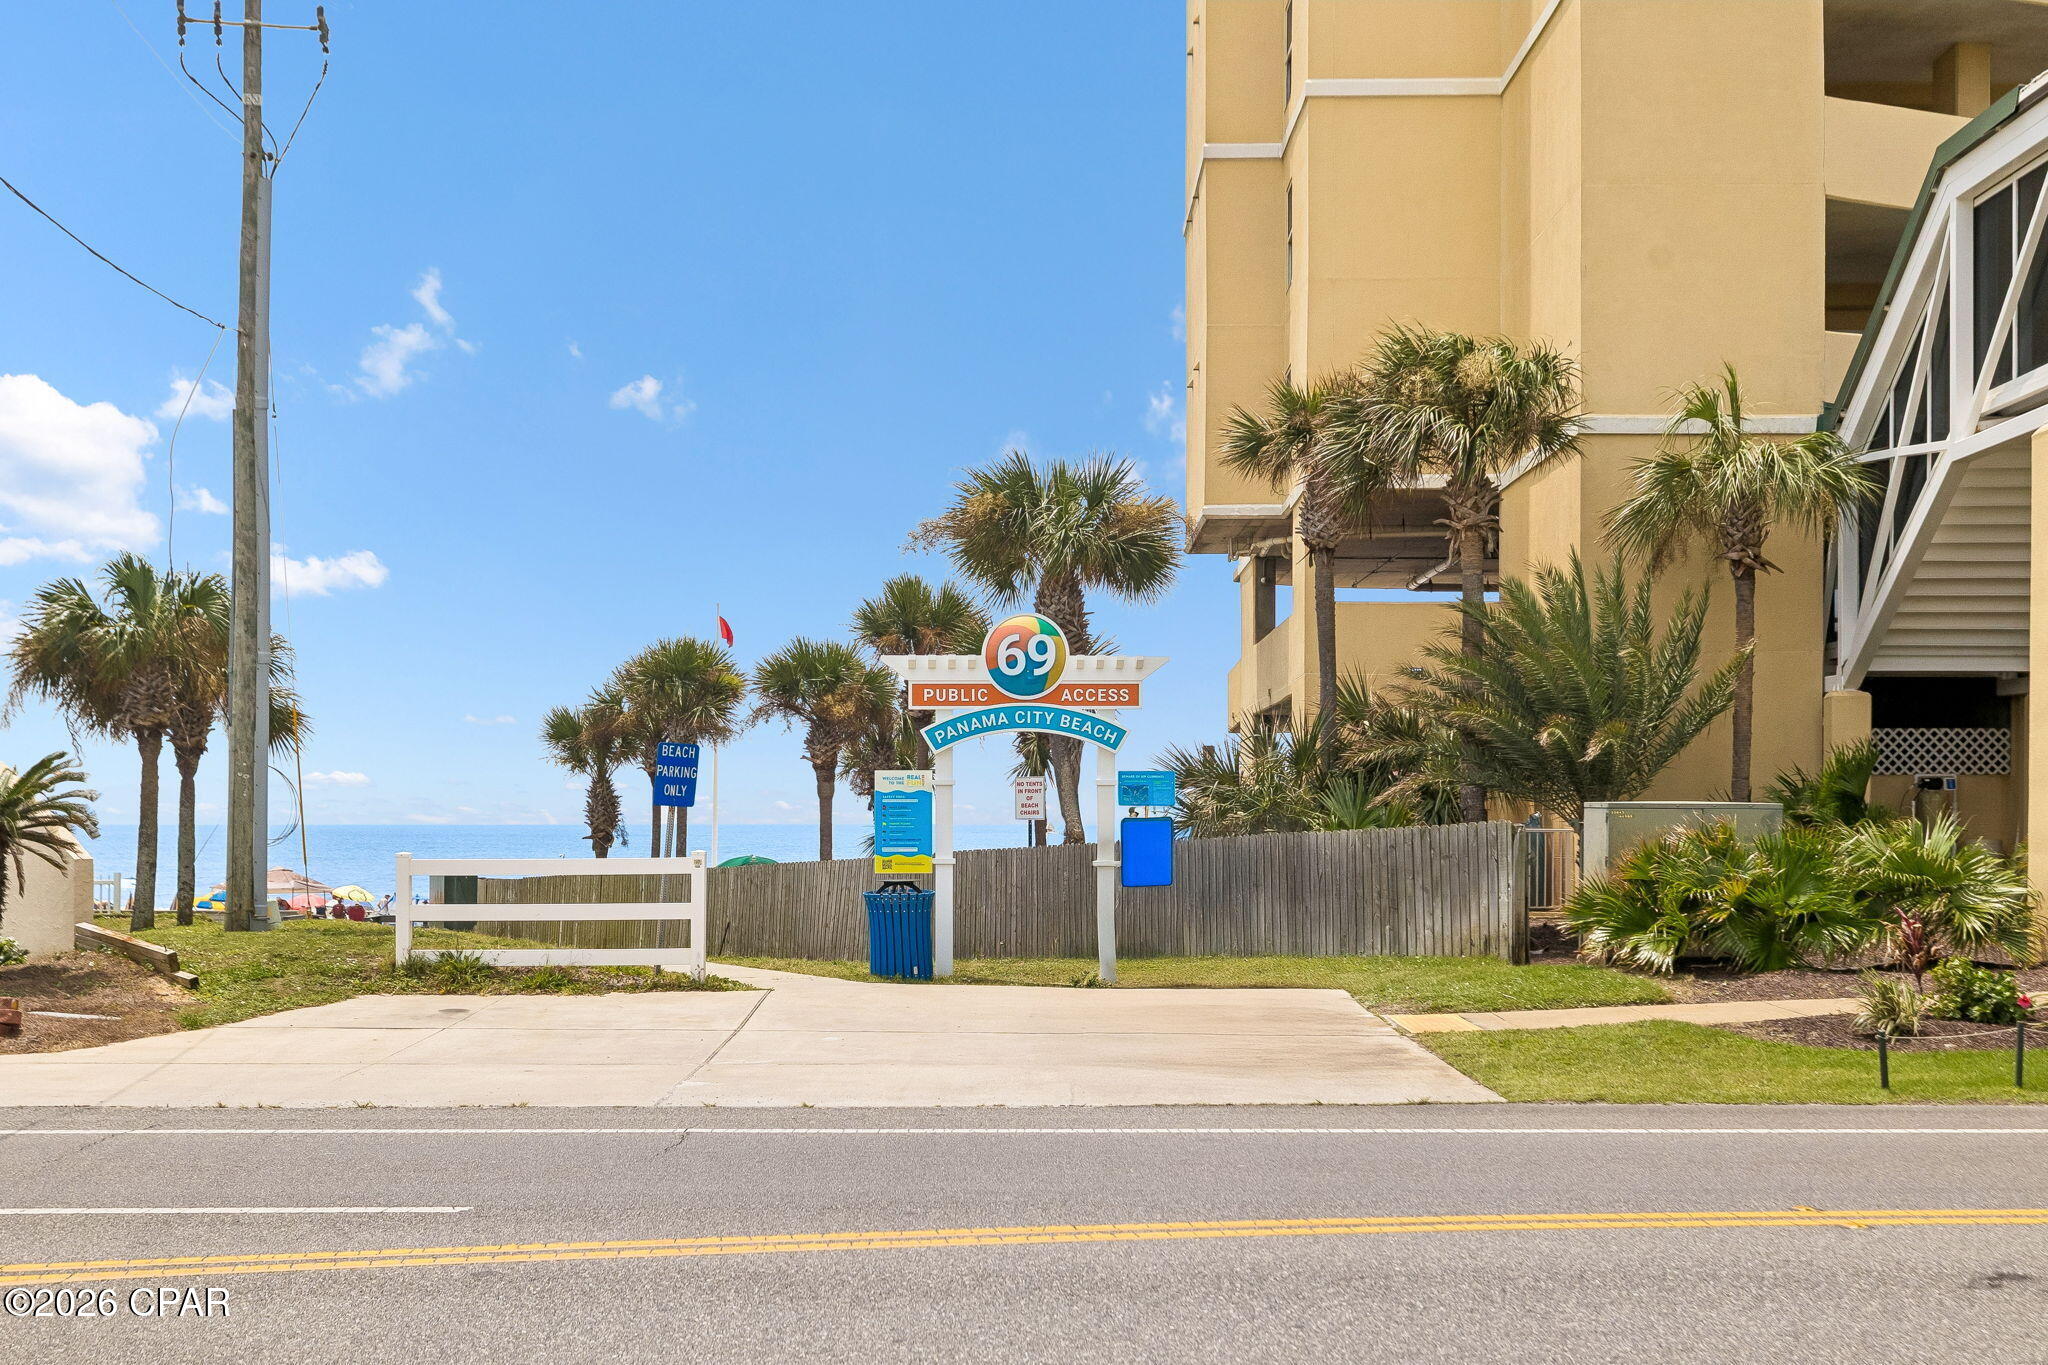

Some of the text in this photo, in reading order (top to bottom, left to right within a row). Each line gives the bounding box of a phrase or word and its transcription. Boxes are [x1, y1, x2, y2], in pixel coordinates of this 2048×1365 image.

[997, 633, 1056, 677] 69
[923, 688, 1130, 702] PUBLIC ACCESS
[934, 710, 1118, 744] PANAMA CITY BEACH
[661, 744, 696, 759] BEACH
[656, 764, 698, 779] PARKING
[663, 783, 687, 796] ONLY
